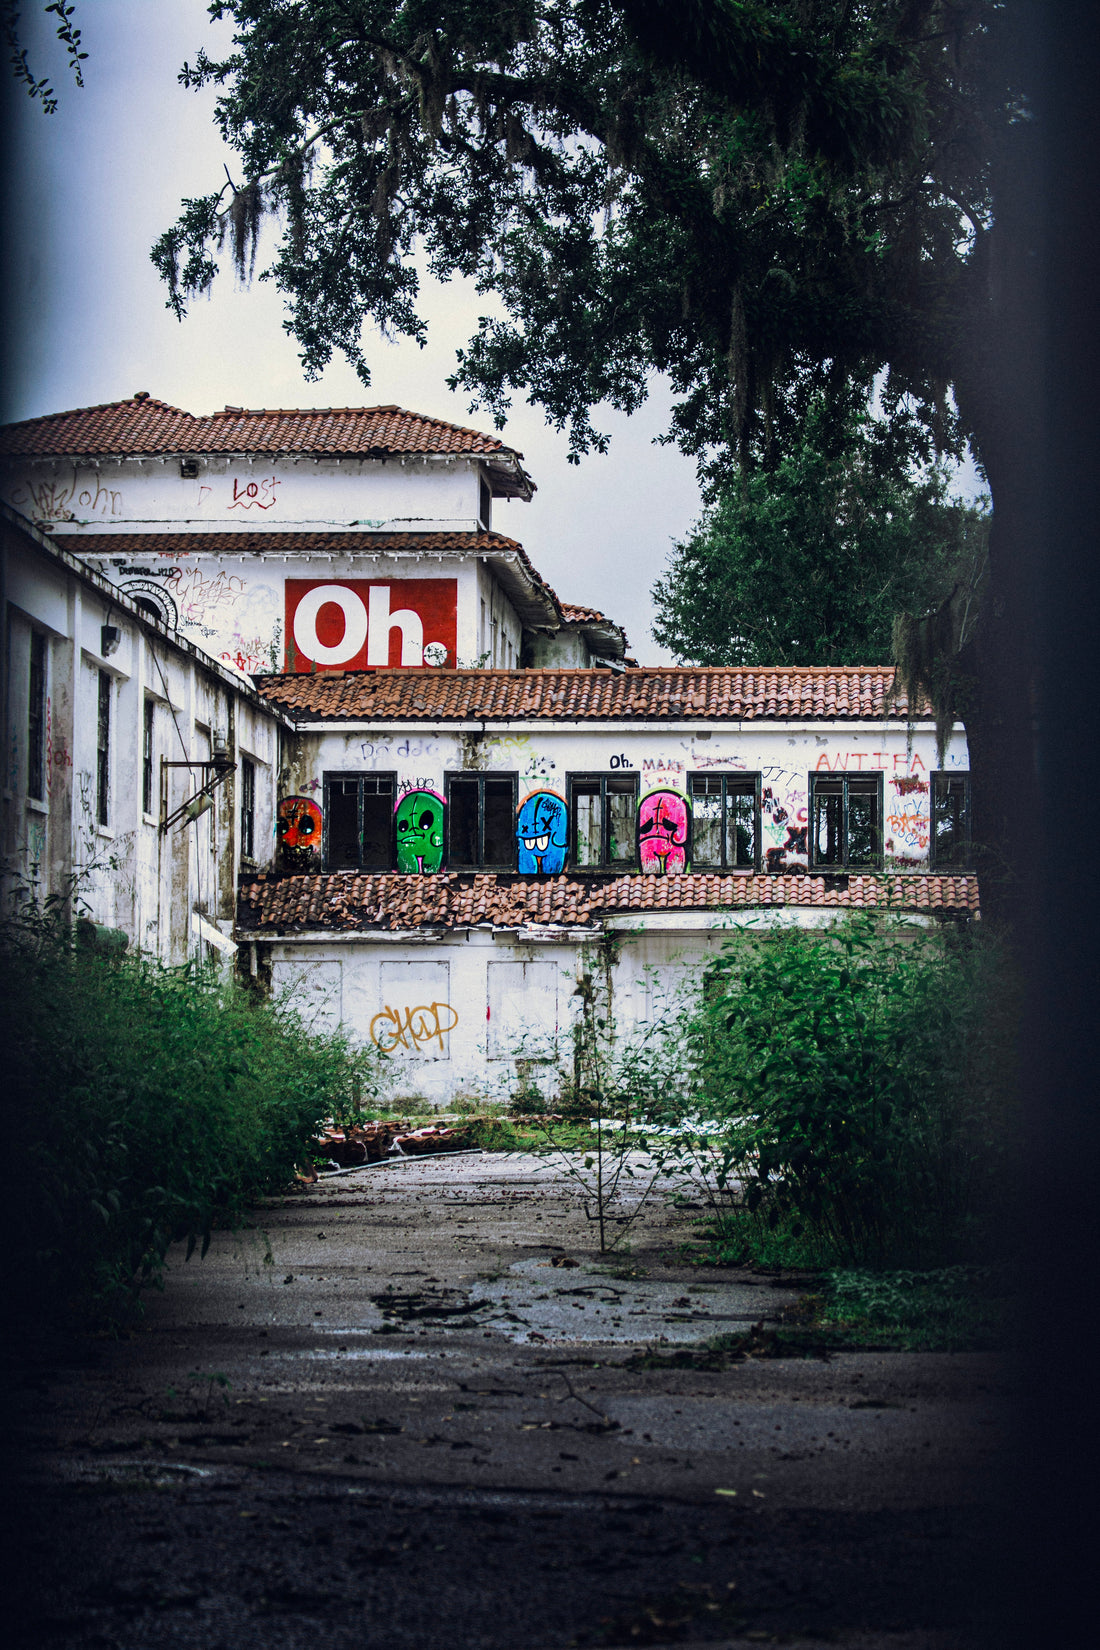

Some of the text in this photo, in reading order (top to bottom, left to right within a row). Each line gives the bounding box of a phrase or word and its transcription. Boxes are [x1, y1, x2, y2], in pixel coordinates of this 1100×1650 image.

[293, 584, 448, 667] Oh.
[609, 753, 634, 769] Oh.
[816, 752, 926, 772] ANTIFA
